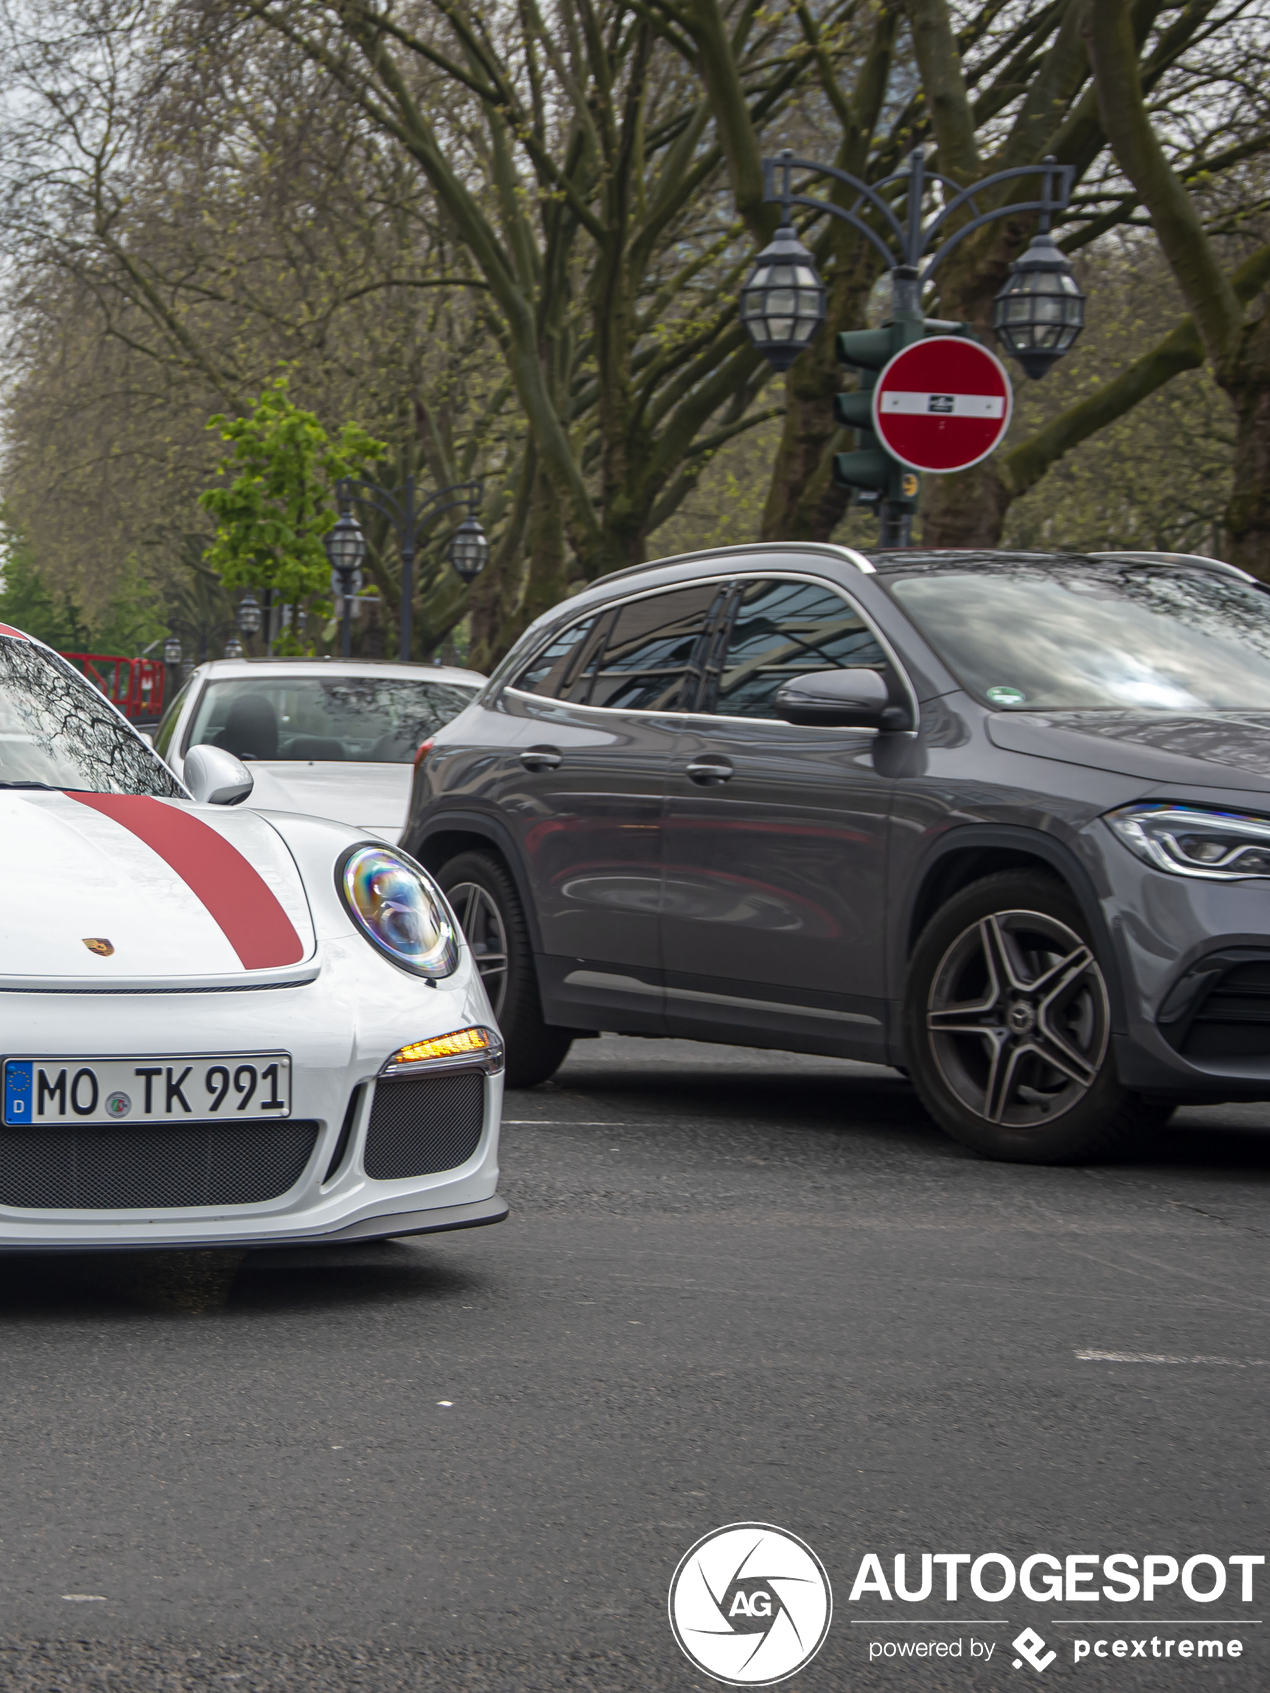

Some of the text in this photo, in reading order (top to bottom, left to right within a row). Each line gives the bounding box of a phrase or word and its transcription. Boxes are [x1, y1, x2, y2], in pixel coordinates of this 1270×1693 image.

[36, 1063, 285, 1116] MO TK 991
[13, 1100, 25, 1113] D
